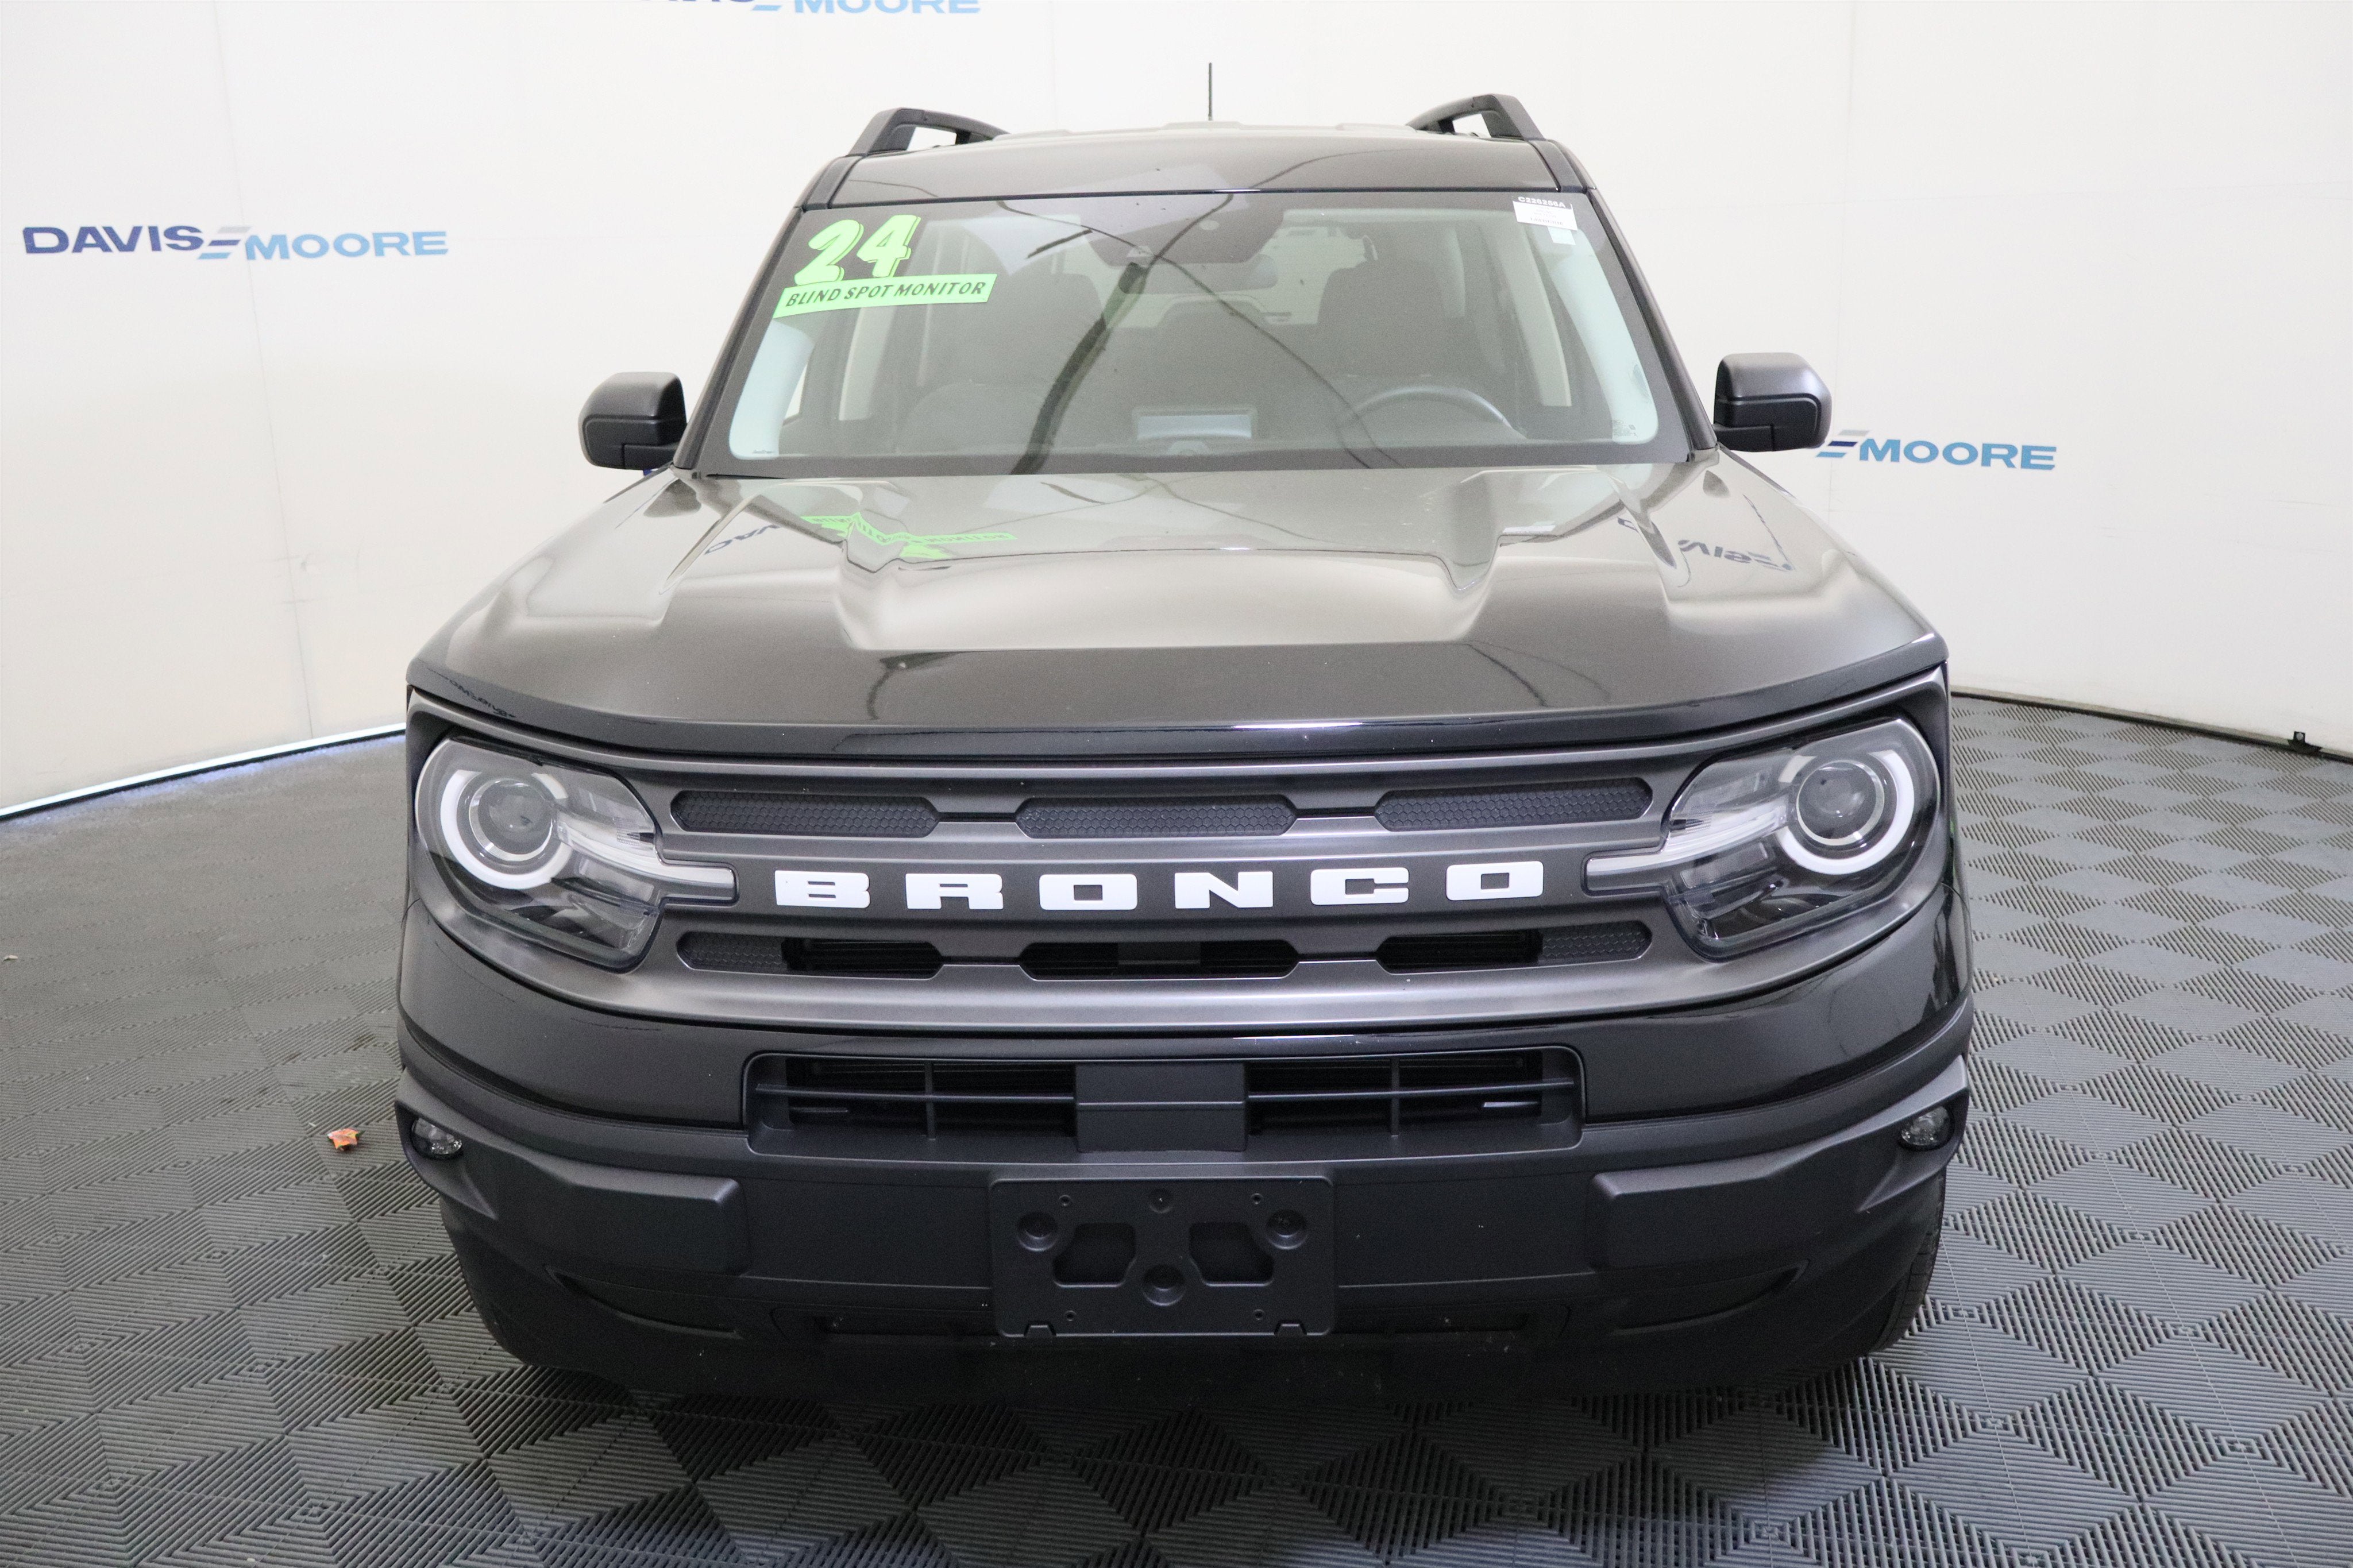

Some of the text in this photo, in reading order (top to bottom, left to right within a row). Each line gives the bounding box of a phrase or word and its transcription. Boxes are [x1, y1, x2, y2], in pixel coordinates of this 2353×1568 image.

[23, 225, 448, 260] DAVIS MOORE
[794, 214, 921, 286] 24
[786, 282, 986, 307] BLIND SPOT MONITOR
[1860, 438, 2057, 470] MOORE
[774, 861, 1544, 910] BRONCO
